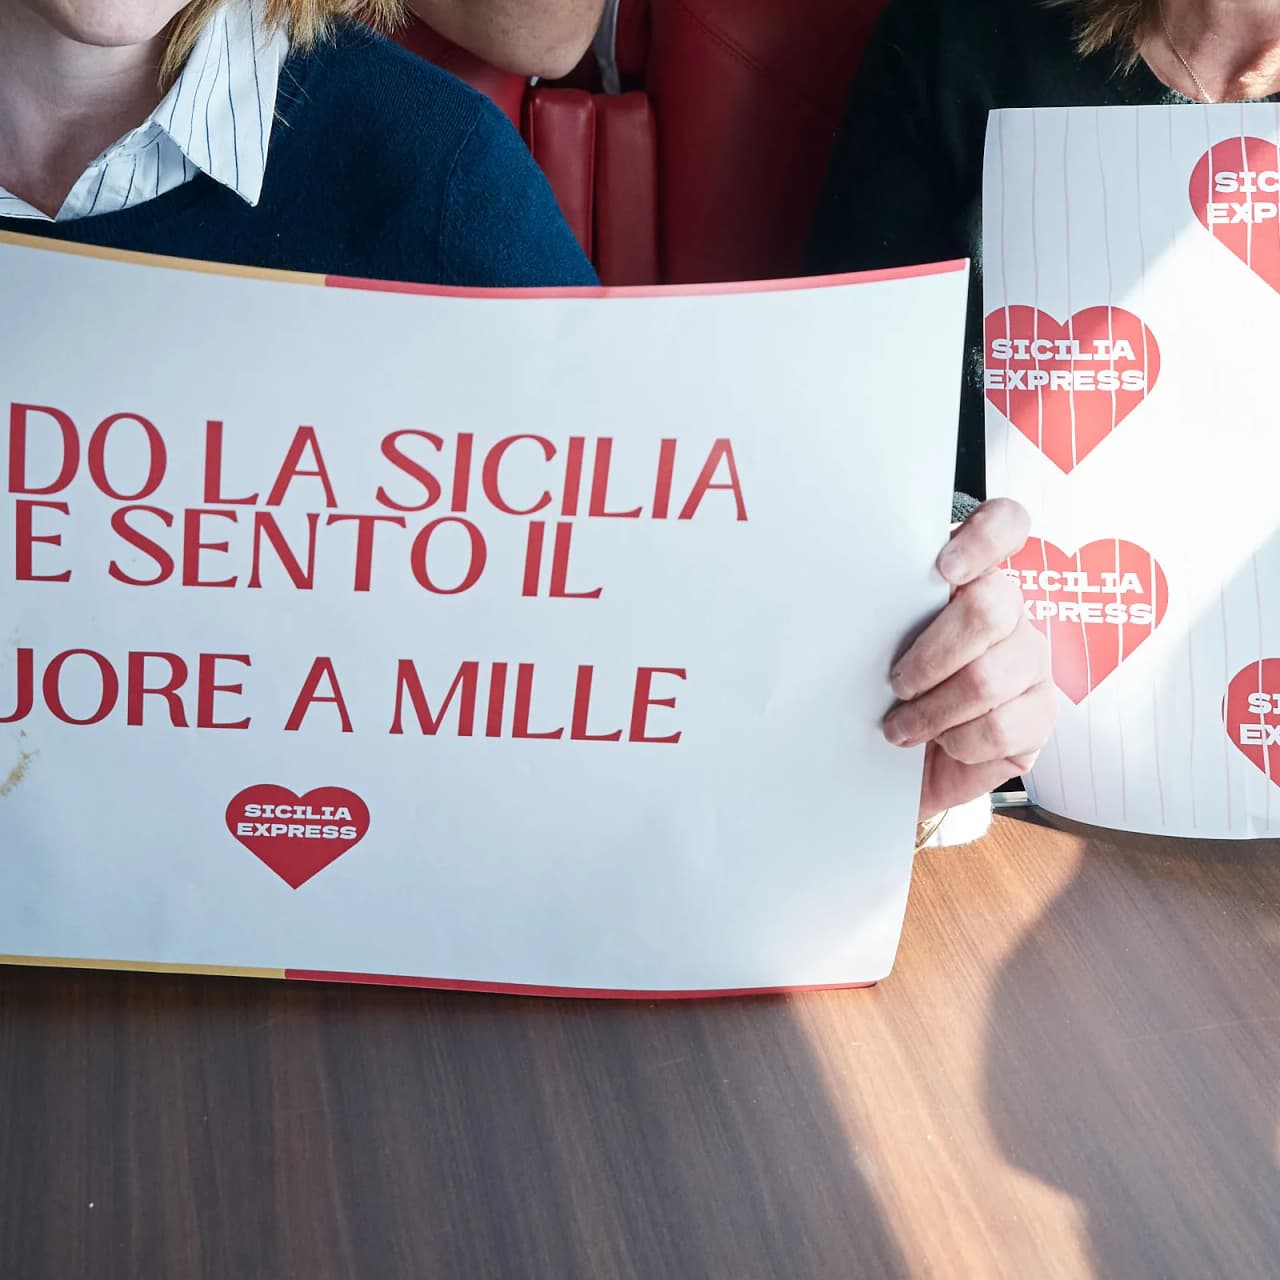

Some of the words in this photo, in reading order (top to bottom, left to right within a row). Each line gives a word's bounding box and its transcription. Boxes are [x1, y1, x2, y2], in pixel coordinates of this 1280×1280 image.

[991, 338, 1137, 361] SICILIA
[984, 369, 1145, 391] EXPRESS
[203, 421, 337, 509] LA
[375, 429, 747, 522] SICILIA
[15, 500, 72, 583] E
[108, 505, 488, 595] SENTO
[521, 520, 604, 599] IL
[1023, 600, 1153, 625] XPRESS
[285, 656, 352, 733] A
[389, 659, 688, 744] MILLE
[244, 803, 352, 821] SICILIA
[237, 822, 357, 840] EXPRESS
